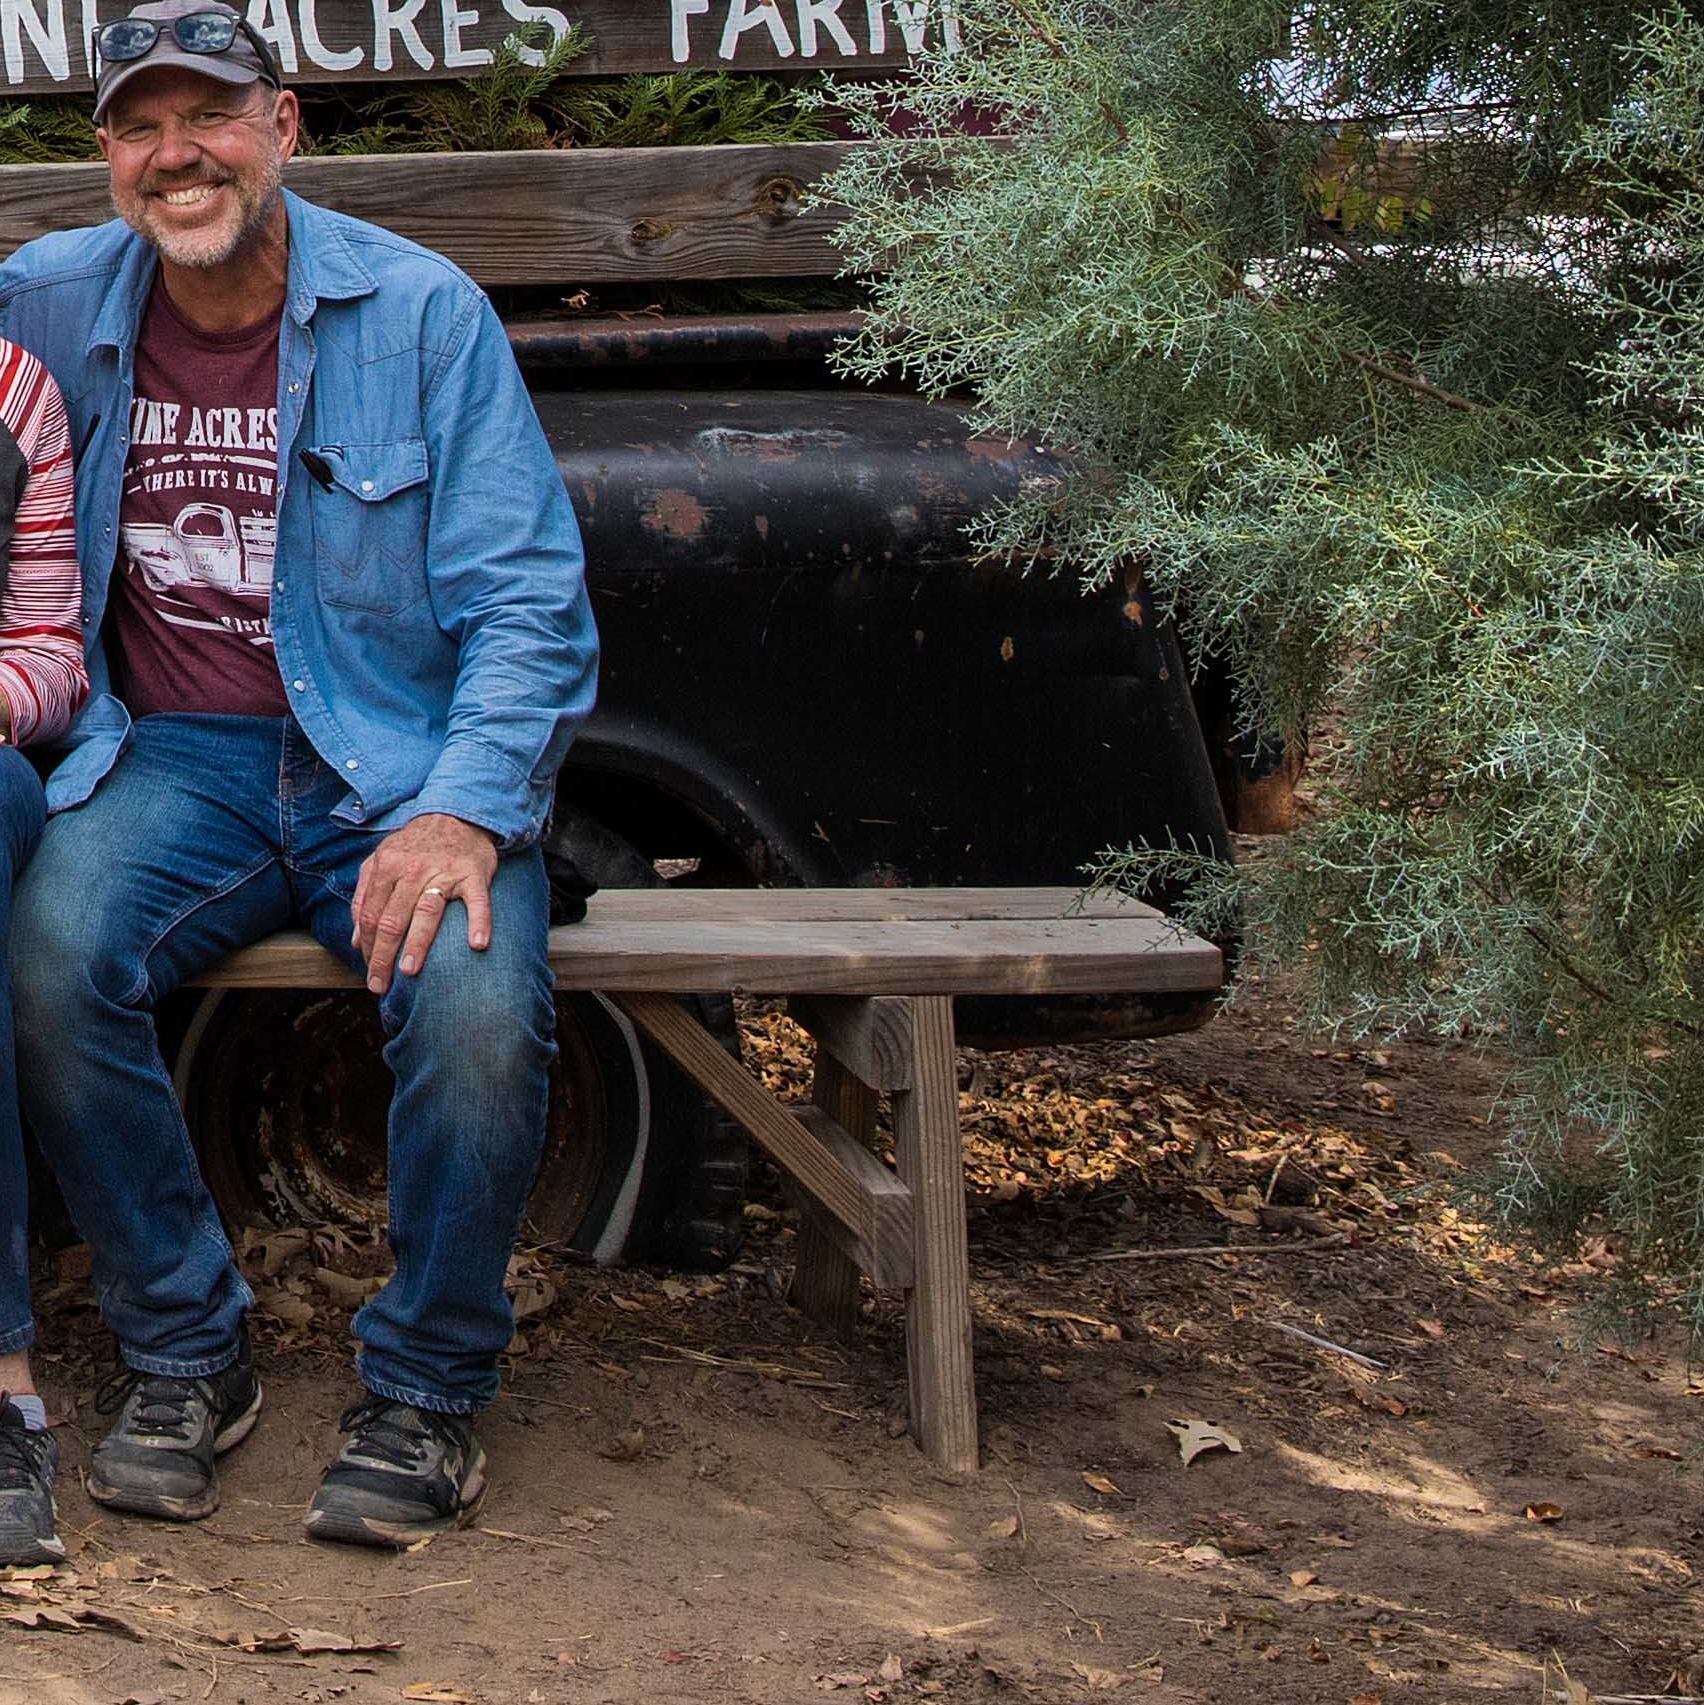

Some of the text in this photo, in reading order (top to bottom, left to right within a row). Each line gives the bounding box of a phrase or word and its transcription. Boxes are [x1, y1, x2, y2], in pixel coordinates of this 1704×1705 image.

[132, 397, 278, 453] INE ACRES
[200, 469, 229, 489] IT'S
